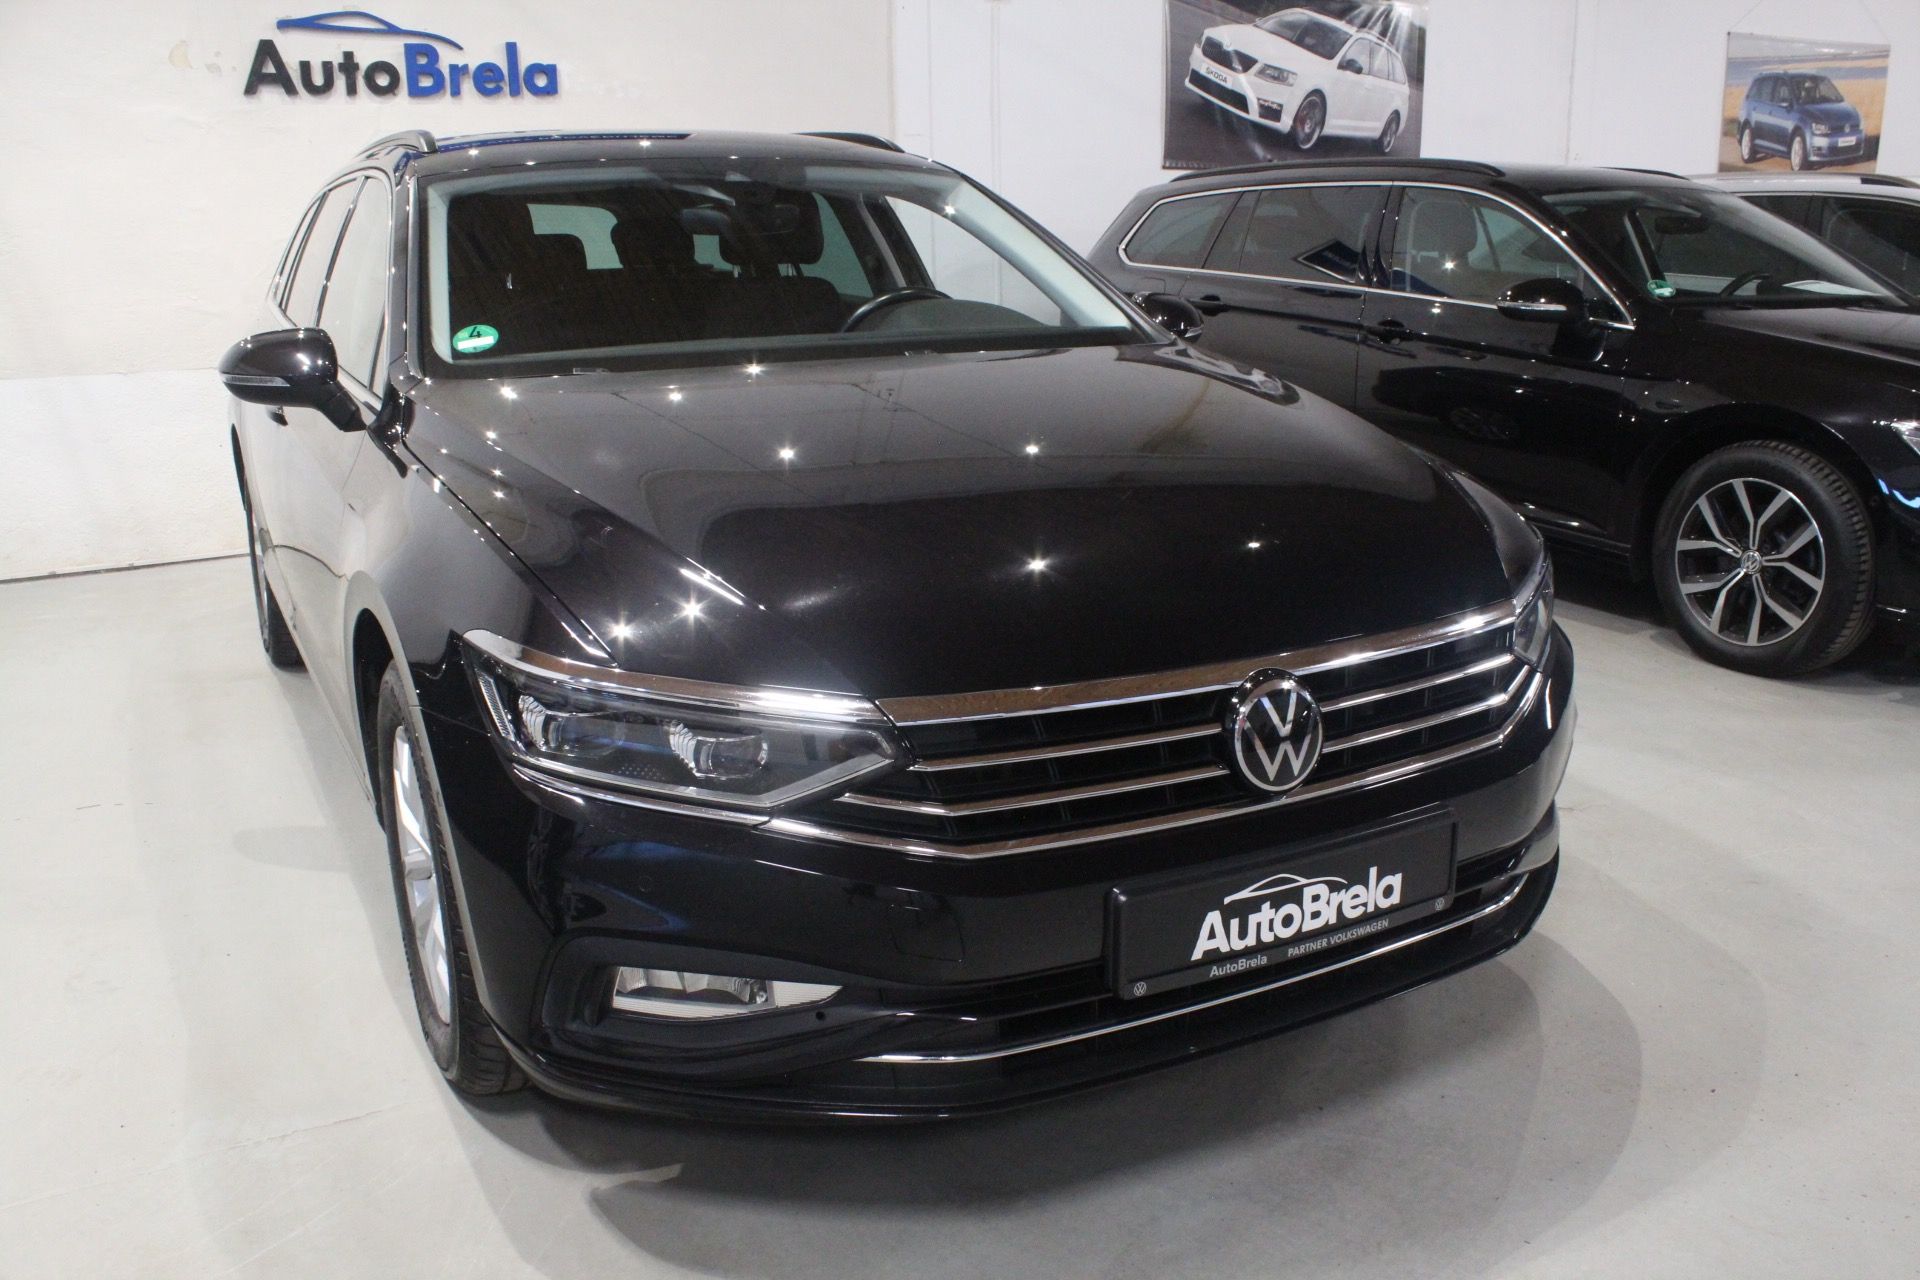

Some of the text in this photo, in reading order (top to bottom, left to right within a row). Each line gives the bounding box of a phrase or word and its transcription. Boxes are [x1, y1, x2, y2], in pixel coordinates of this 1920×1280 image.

[244, 39, 558, 97] AutoBrela
[469, 326, 482, 338] 4
[1190, 866, 1402, 960] AutoBrela
[1287, 918, 1389, 957] PARTNER VOLKSWAGEN
[1209, 954, 1267, 978] AutoBrela
